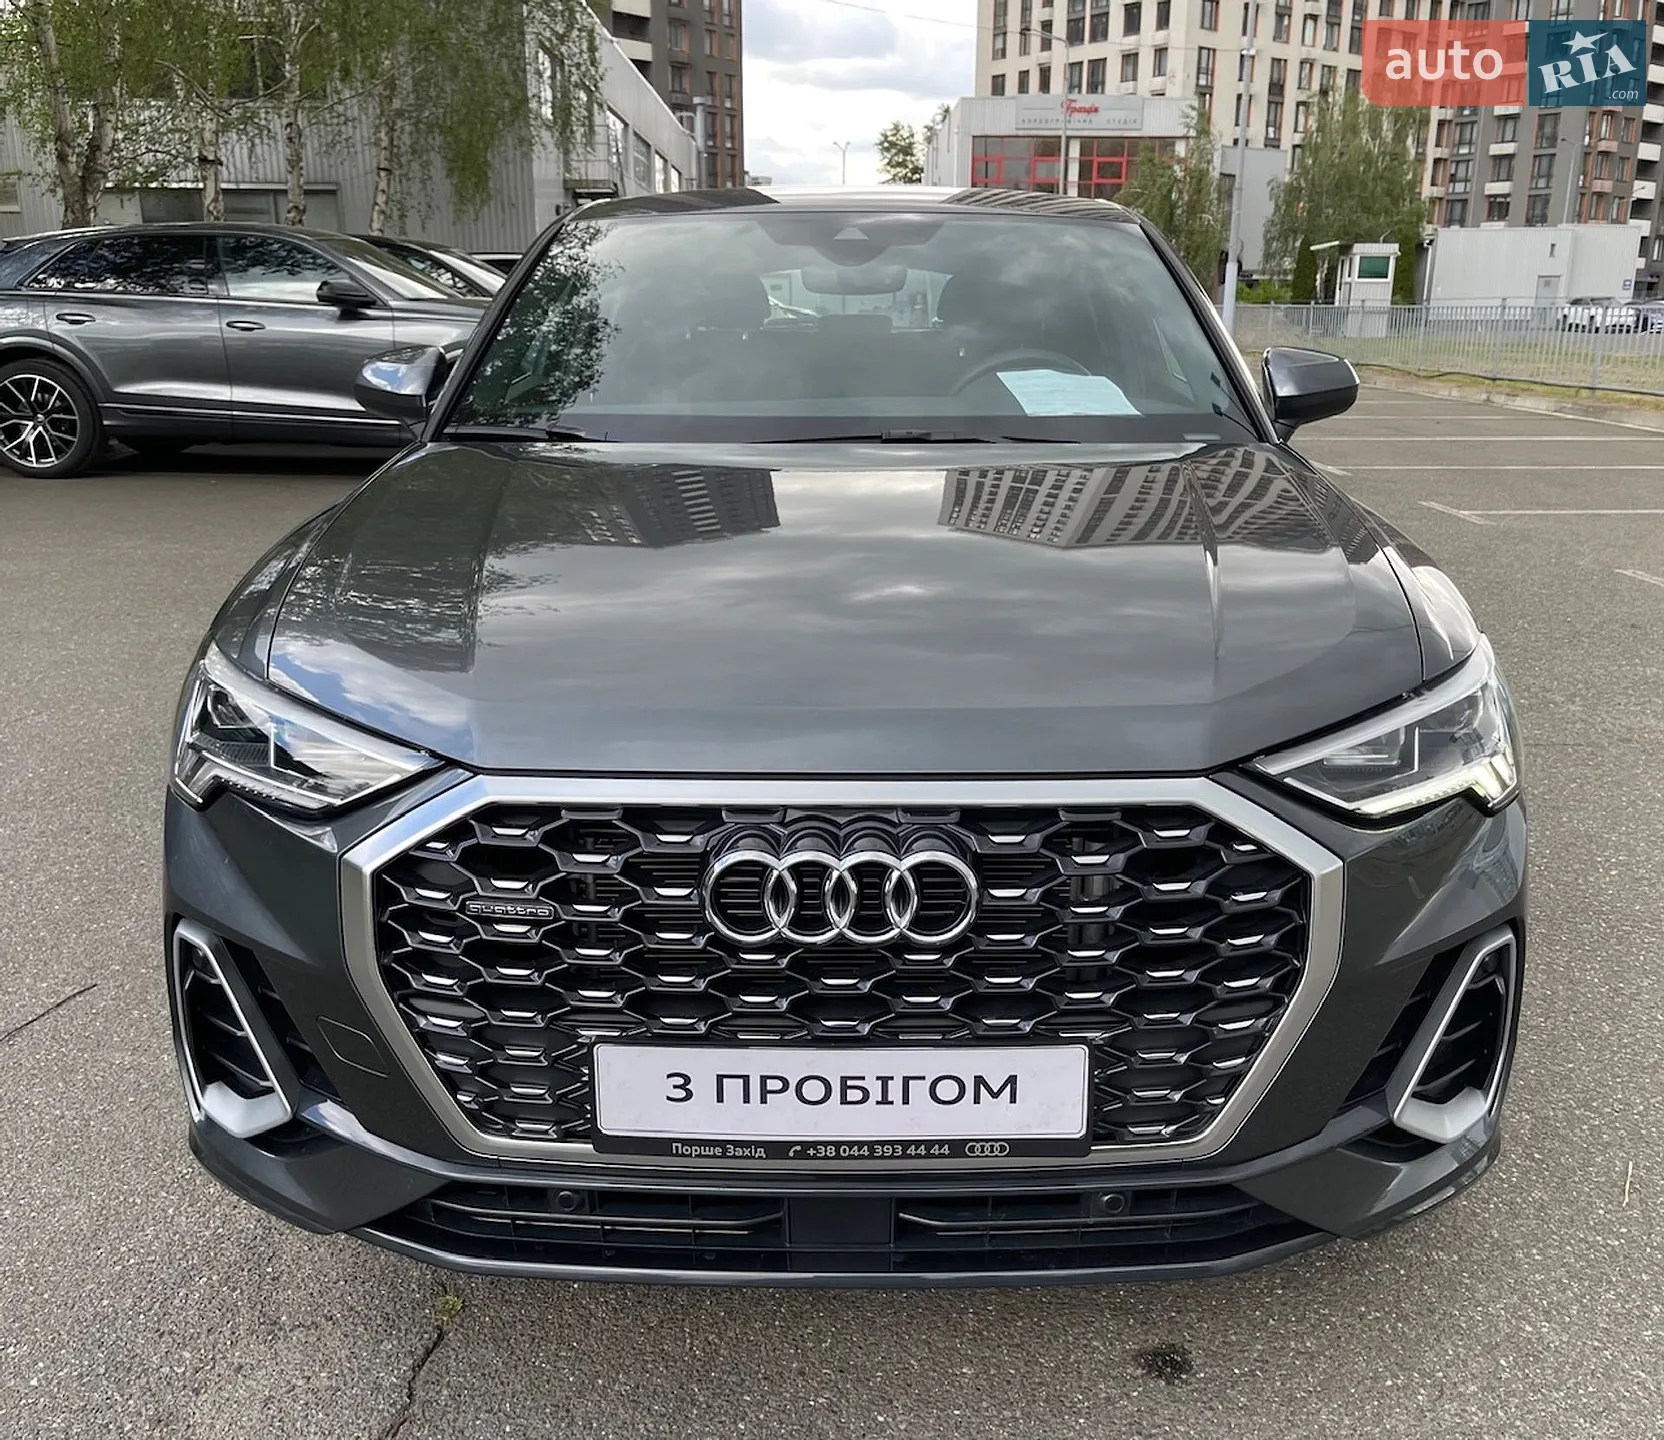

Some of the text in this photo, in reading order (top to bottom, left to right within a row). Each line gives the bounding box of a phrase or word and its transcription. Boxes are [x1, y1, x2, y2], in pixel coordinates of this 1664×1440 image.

[468, 903, 551, 917] quattro
[715, 1073, 1019, 1106] ПРОБІГОМ
[671, 1142, 951, 1159] Порше Захід +38 044 393 44 44
